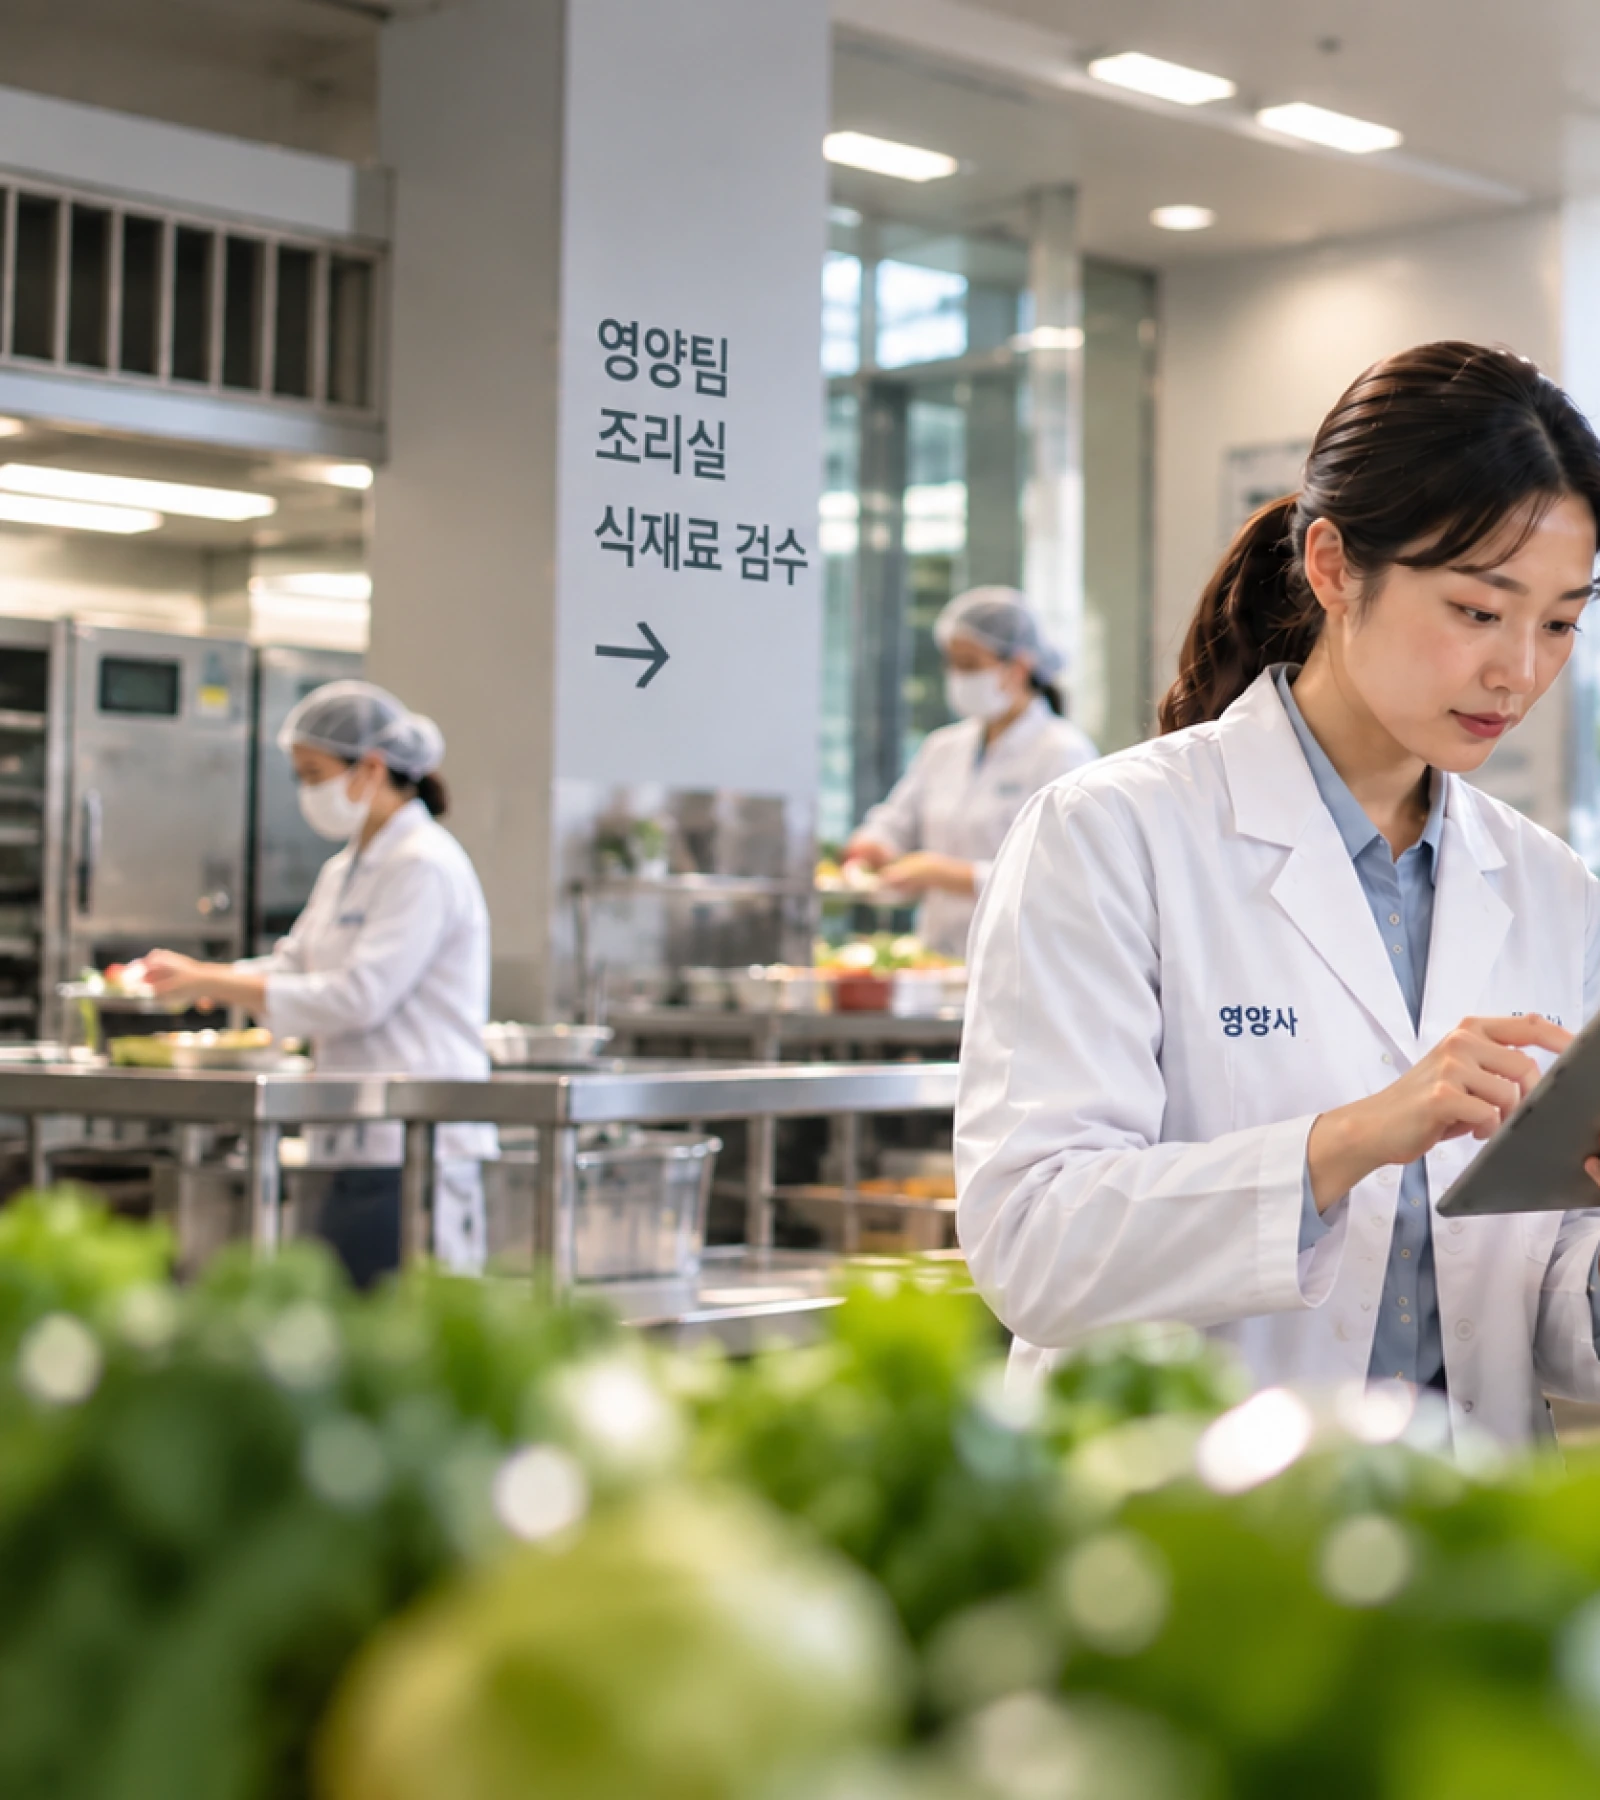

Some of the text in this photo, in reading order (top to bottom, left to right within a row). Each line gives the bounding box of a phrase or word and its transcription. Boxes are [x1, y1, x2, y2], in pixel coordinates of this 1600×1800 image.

[598, 318, 728, 398] 영양팀
[595, 408, 726, 481] 조리실
[594, 504, 809, 586] 식재료 검수
[1218, 1004, 1299, 1038] 영양사
